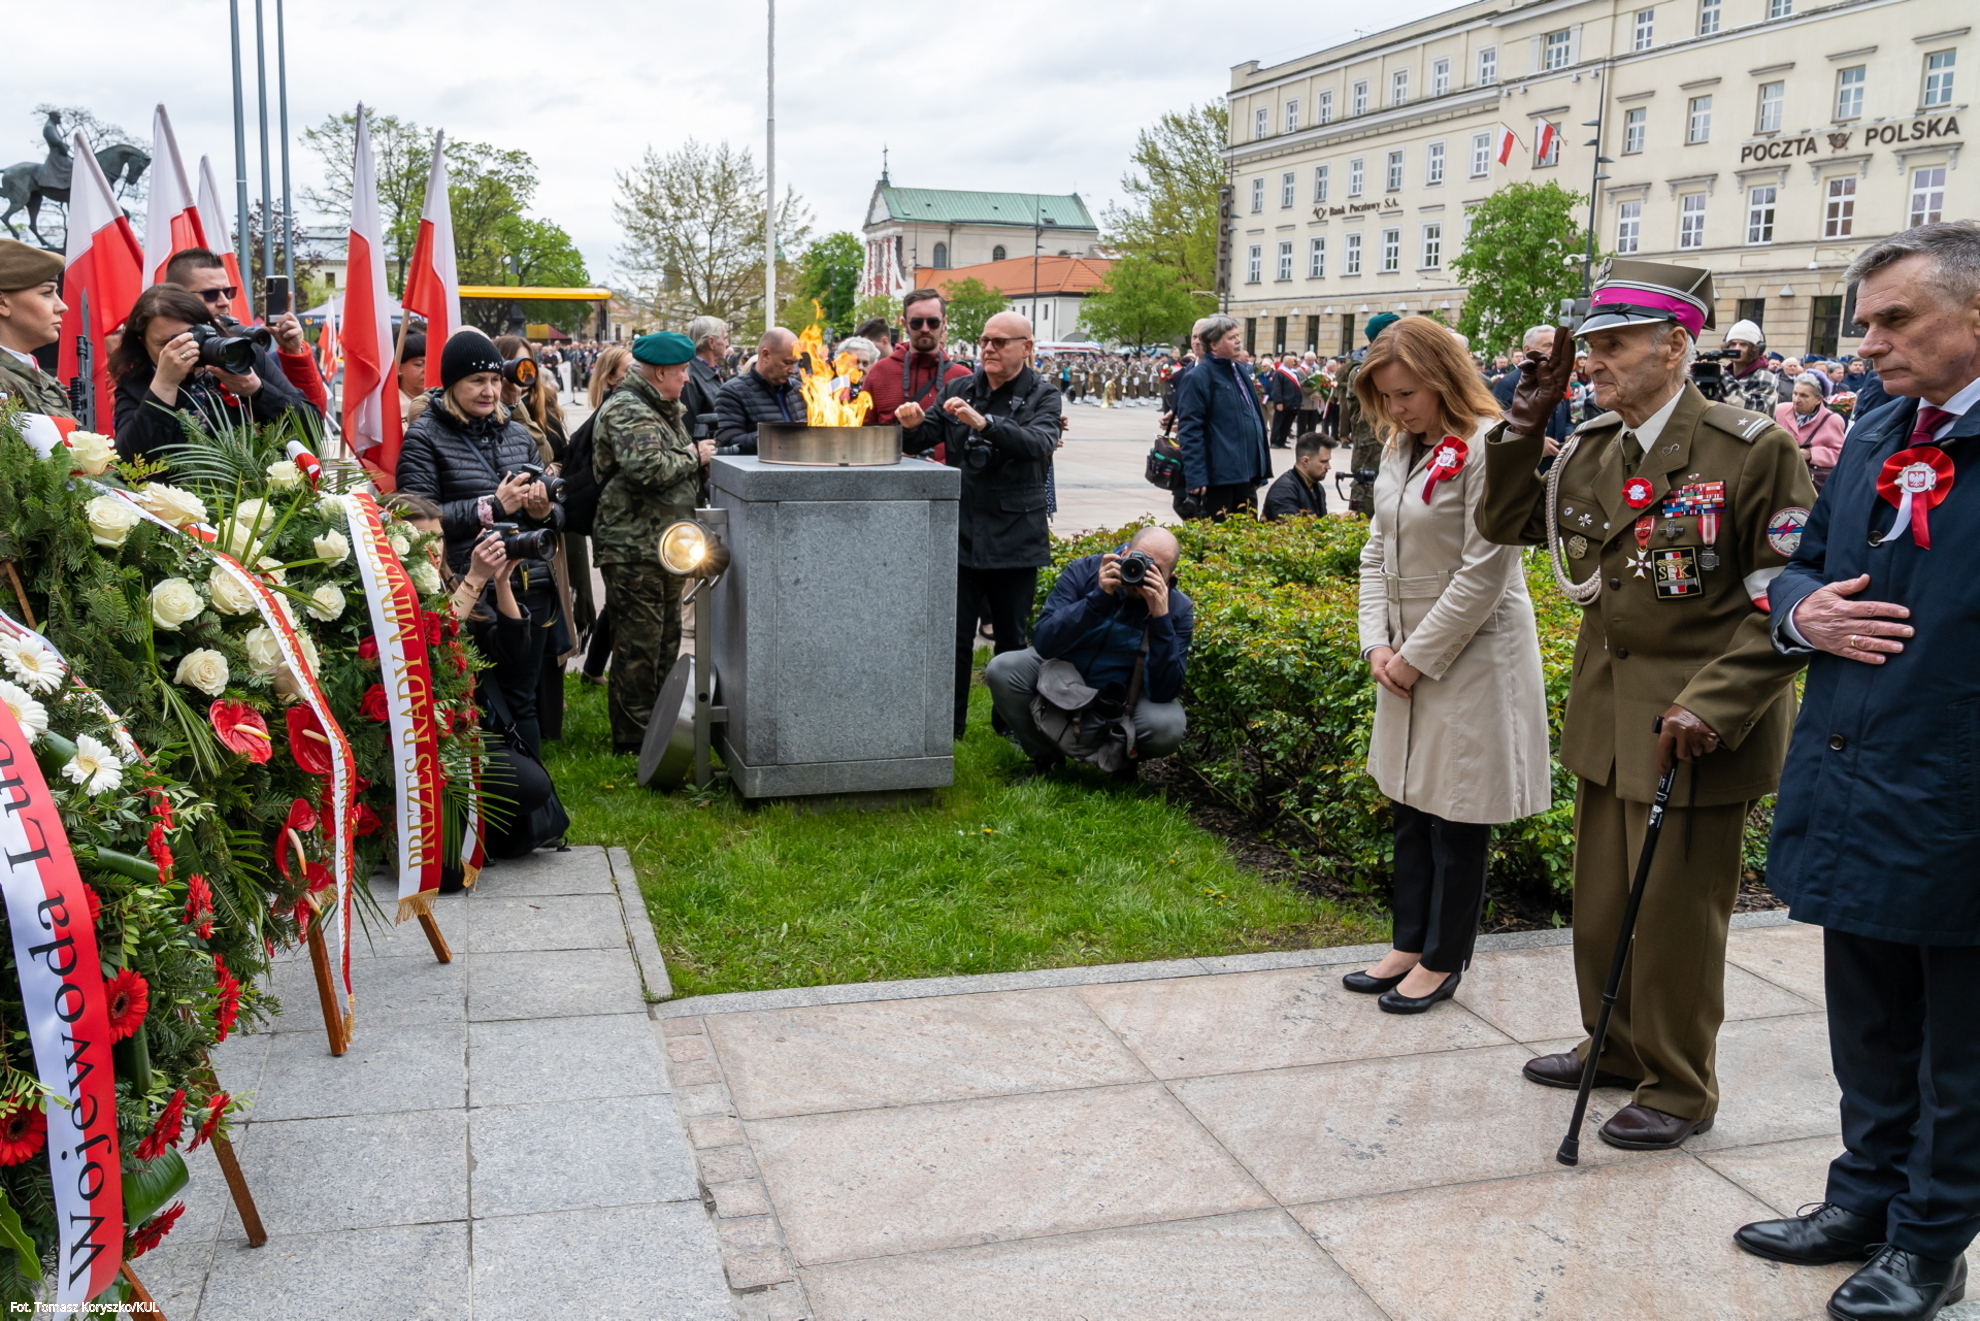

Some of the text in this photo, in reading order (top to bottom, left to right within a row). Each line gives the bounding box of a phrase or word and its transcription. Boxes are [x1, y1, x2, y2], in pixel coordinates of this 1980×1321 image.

[1741, 116, 1960, 163] POCZTA POLSKA
[1329, 197, 1399, 216] Bank Pocztowy S.A.
[1659, 565, 1692, 580] SPK
[349, 494, 435, 871] PREZES RADY MINISTRÓW
[28, 890, 113, 1291] Wojewoda
